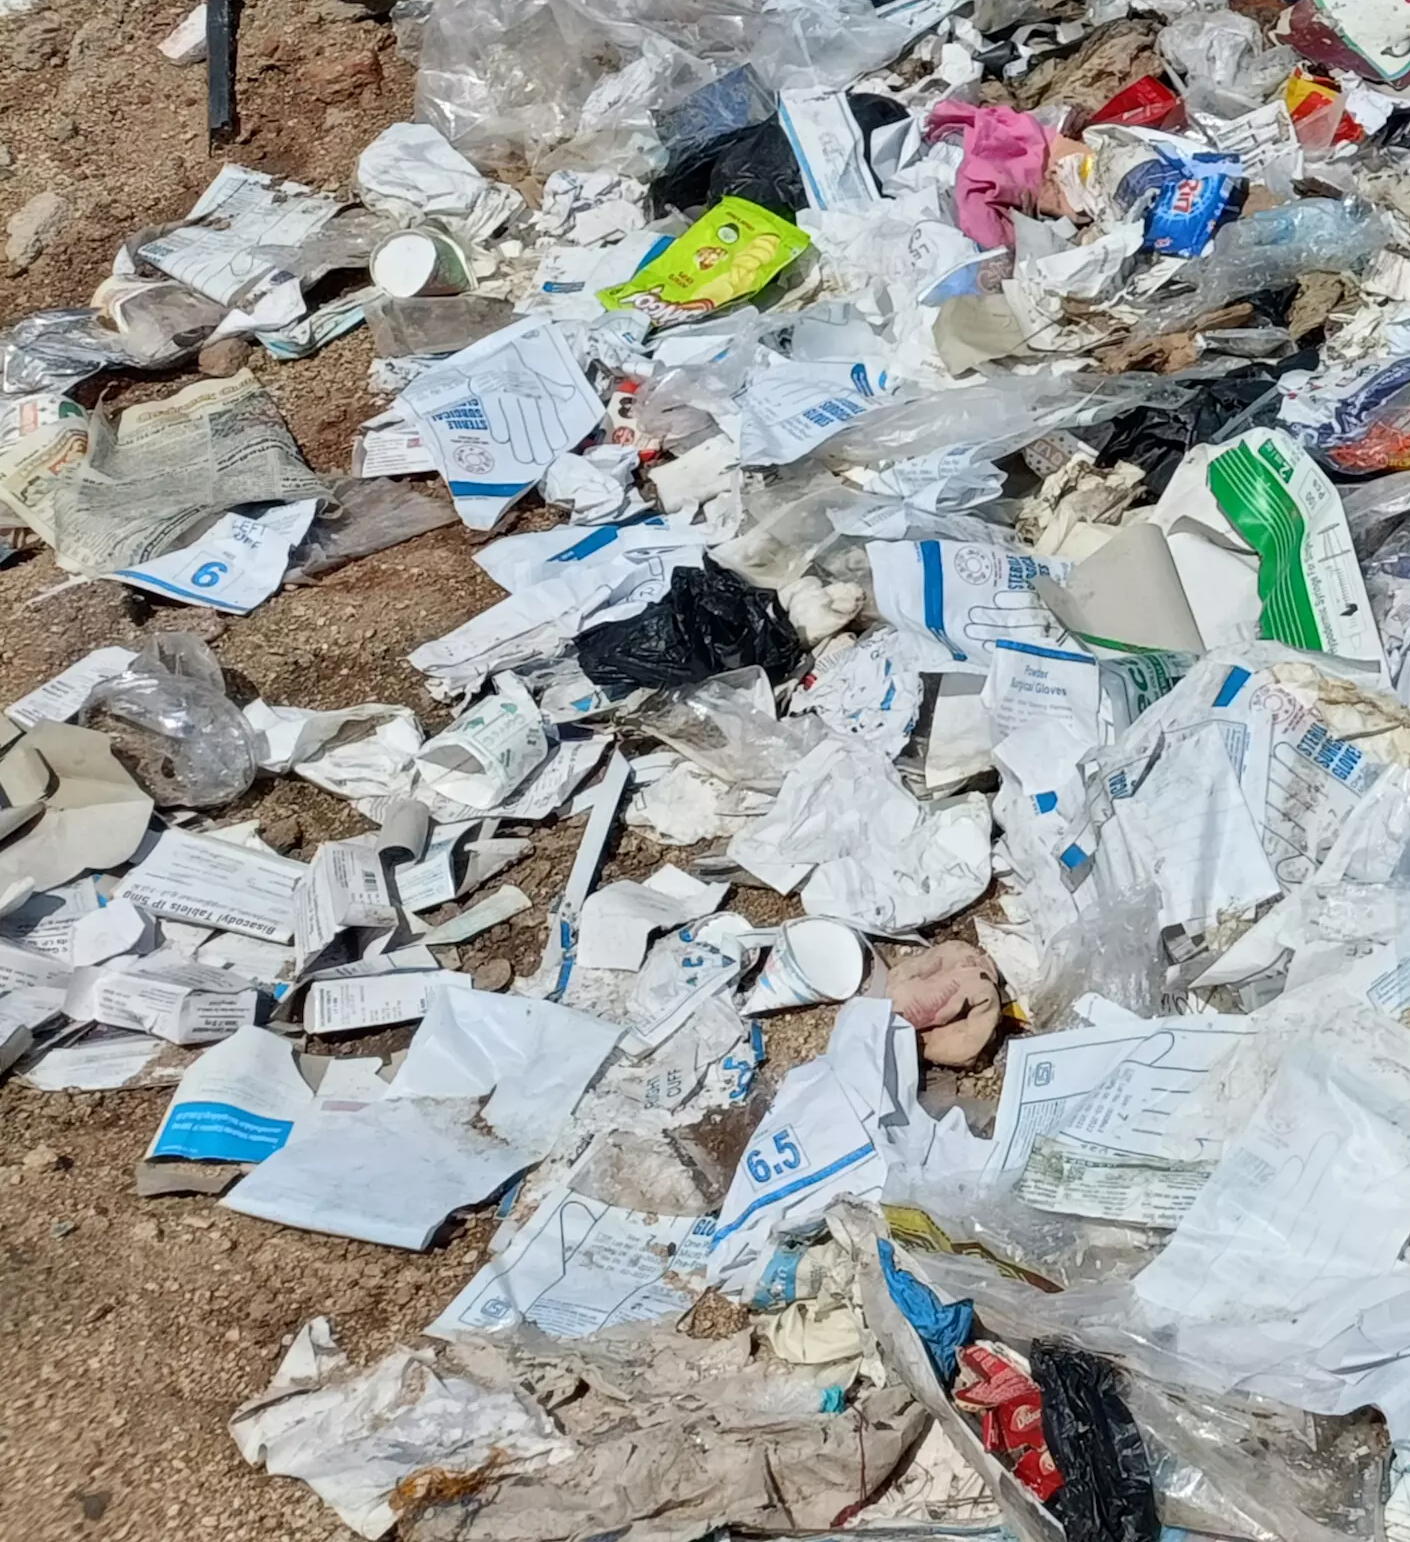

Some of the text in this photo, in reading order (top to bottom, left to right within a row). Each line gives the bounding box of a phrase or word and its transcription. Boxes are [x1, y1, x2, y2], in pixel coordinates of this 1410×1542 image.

[191, 561, 229, 588] 6
[1024, 664, 1049, 680] Powder
[1035, 682, 1068, 698] Gloves
[122, 890, 277, 936] Bisacodyl Tablets IP 5mg
[666, 1068, 683, 1098] CUFF
[747, 1129, 801, 1183] 6.5
